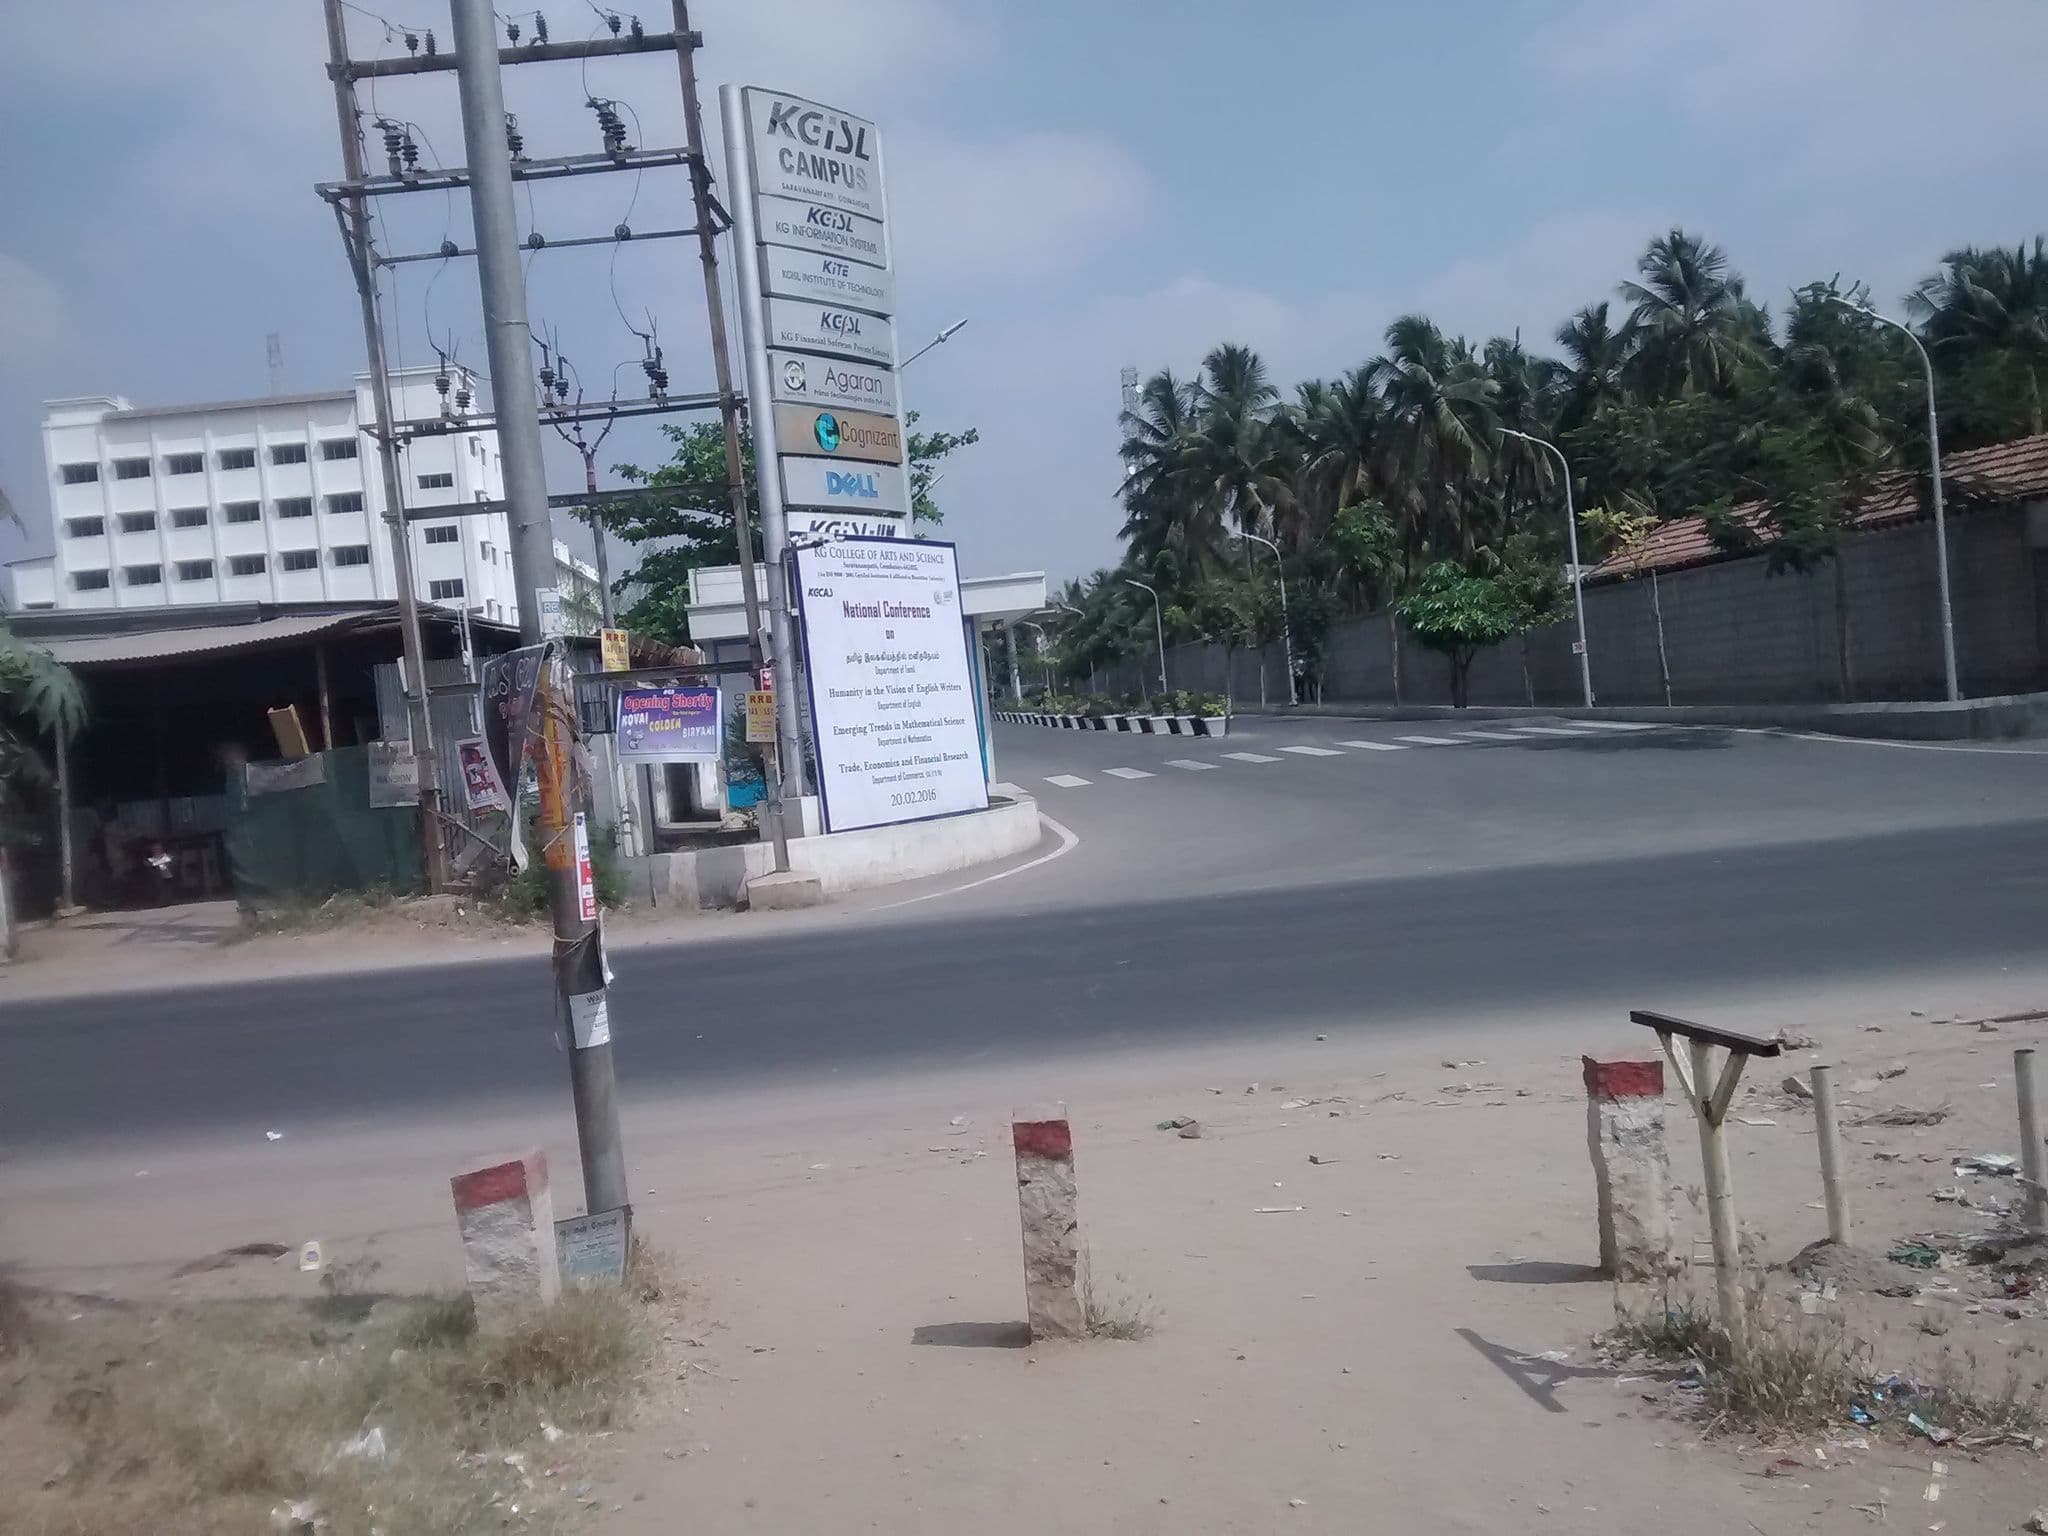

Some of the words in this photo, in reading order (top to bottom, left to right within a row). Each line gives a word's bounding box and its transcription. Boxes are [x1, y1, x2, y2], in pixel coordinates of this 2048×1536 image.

[779, 147, 868, 191] CAMPUS
[775, 221, 789, 233] KG
[793, 224, 848, 246] INFORMATION
[850, 237, 877, 254] SYSTEMS
[802, 274, 836, 287] INSTITUTE
[781, 331, 793, 341] KG
[841, 421, 898, 448] Cognizant
[826, 471, 878, 498] DELL
[814, 547, 827, 558] KG
[843, 600, 881, 618] National
[883, 600, 931, 618] Conference
[885, 629, 895, 639] on
[829, 687, 863, 699] Humanity
[865, 686, 872, 696] in
[873, 685, 884, 696] the
[886, 685, 906, 696] Vision
[907, 684, 914, 694] of
[916, 683, 938, 695] English
[940, 682, 962, 692] Writers
[624, 695, 670, 712] Opening
[671, 693, 714, 711] Shortly
[749, 695, 772, 704] RRB
[878, 701, 902, 711] Department
[621, 712, 648, 727] KOVAI
[833, 725, 867, 737] Emerging
[869, 722, 893, 733] Trends
[894, 721, 901, 731] in
[902, 718, 943, 730] Mathematical
[944, 717, 965, 727] Science
[683, 725, 715, 738] BIRYANI
[878, 737, 902, 747] Department
[839, 762, 863, 774] Trade,
[864, 758, 900, 771] Economics
[901, 756, 913, 767] and
[914, 753, 942, 766] Financial
[943, 751, 969, 762] Research
[891, 788, 937, 807] 20.02.2016
